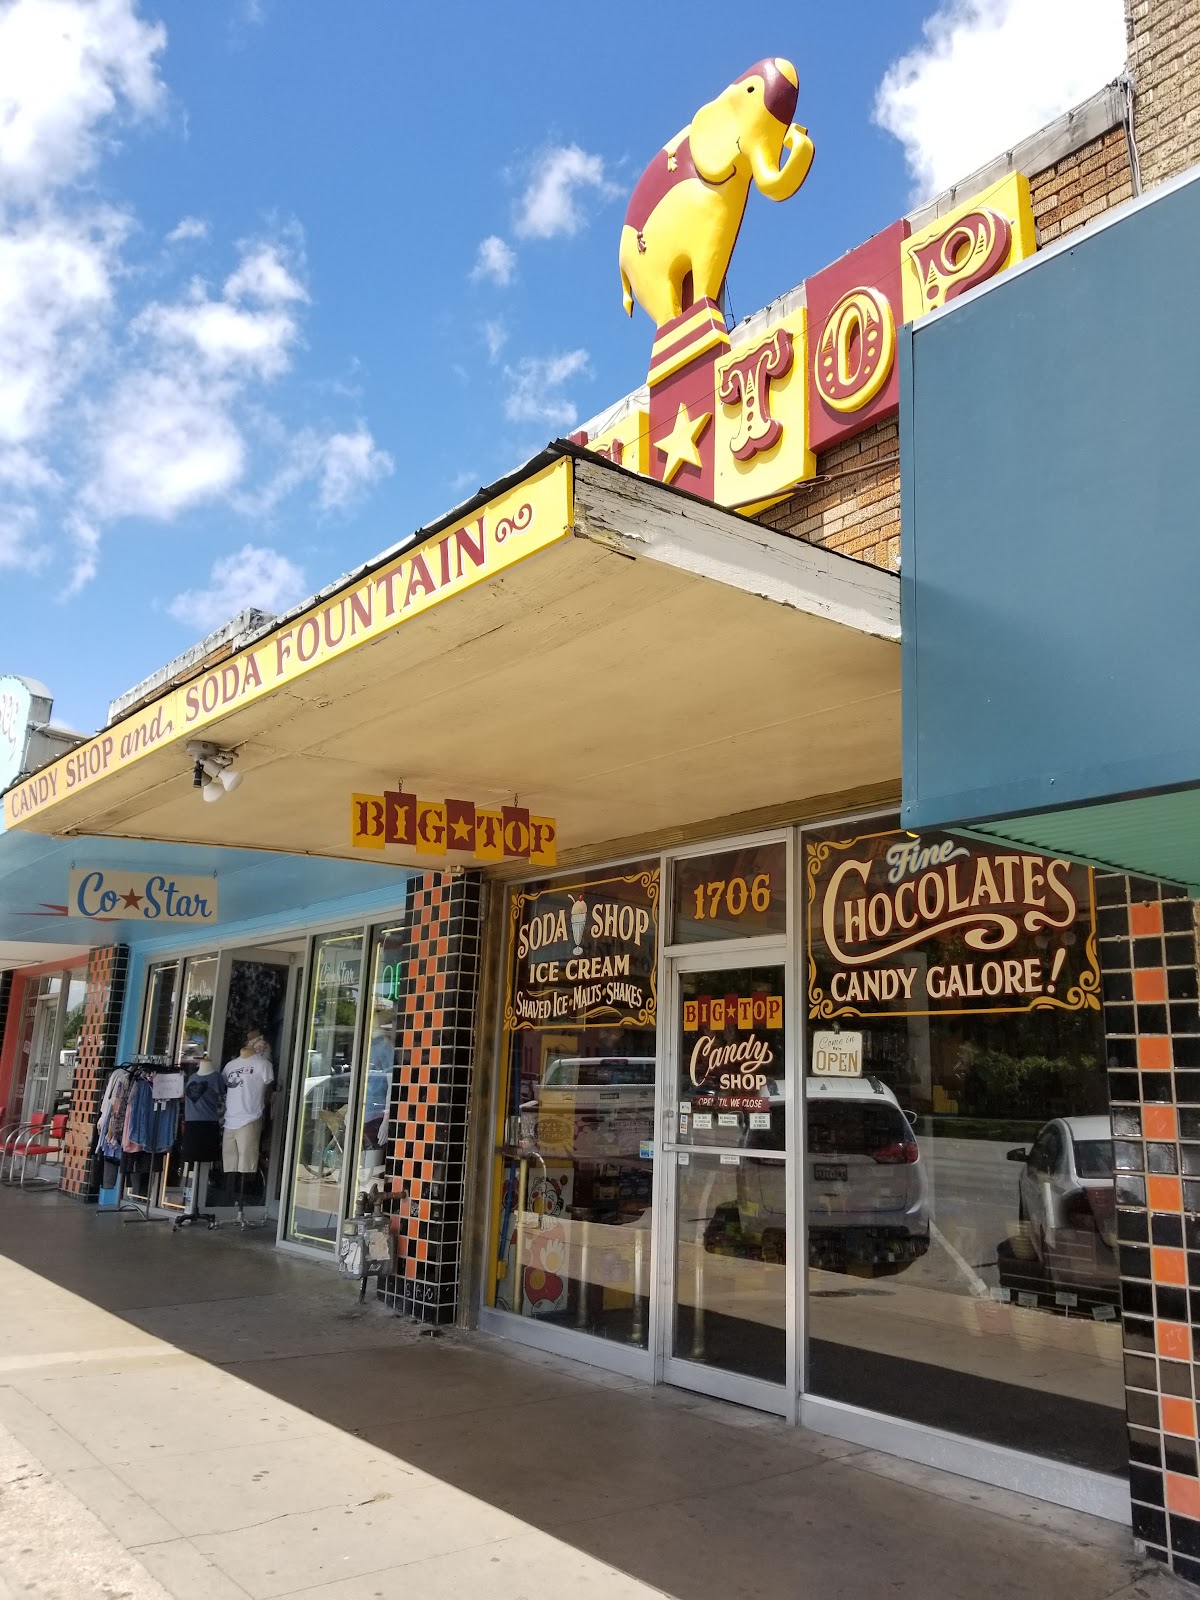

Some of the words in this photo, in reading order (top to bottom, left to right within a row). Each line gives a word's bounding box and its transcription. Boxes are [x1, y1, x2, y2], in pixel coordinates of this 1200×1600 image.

[718, 207, 1013, 462] TOP
[11, 768, 59, 818] CANDY
[66, 736, 114, 789] SHOP
[185, 653, 263, 722] SODA
[276, 515, 486, 677] FOUNTAIN
[356, 801, 446, 844] BIG
[476, 815, 556, 854] TOP
[886, 838, 971, 884] Fine
[143, 876, 213, 919] Star
[693, 873, 771, 920] 1706
[823, 855, 1077, 965] CHOCOLATES
[517, 909, 569, 959] SODA
[590, 903, 650, 946] SHOP
[529, 961, 560, 983] ICE
[565, 953, 631, 981] CREAM
[830, 967, 918, 1003] CANDY
[926, 947, 1067, 999] GALORE!
[515, 990, 552, 1019] SHAVED
[553, 991, 569, 1017] ICE
[573, 984, 602, 1011] MALTS
[605, 982, 643, 1009] SHAKES
[685, 1004, 723, 1023] BIG
[740, 1000, 781, 1020] TOP
[690, 1033, 774, 1087] Candy
[816, 1050, 858, 1073] OPEN
[819, 1036, 843, 1050] Come
[719, 1074, 767, 1090] SHOP
[730, 1098, 741, 1108] WE
[741, 1098, 763, 1108] CLOSE
